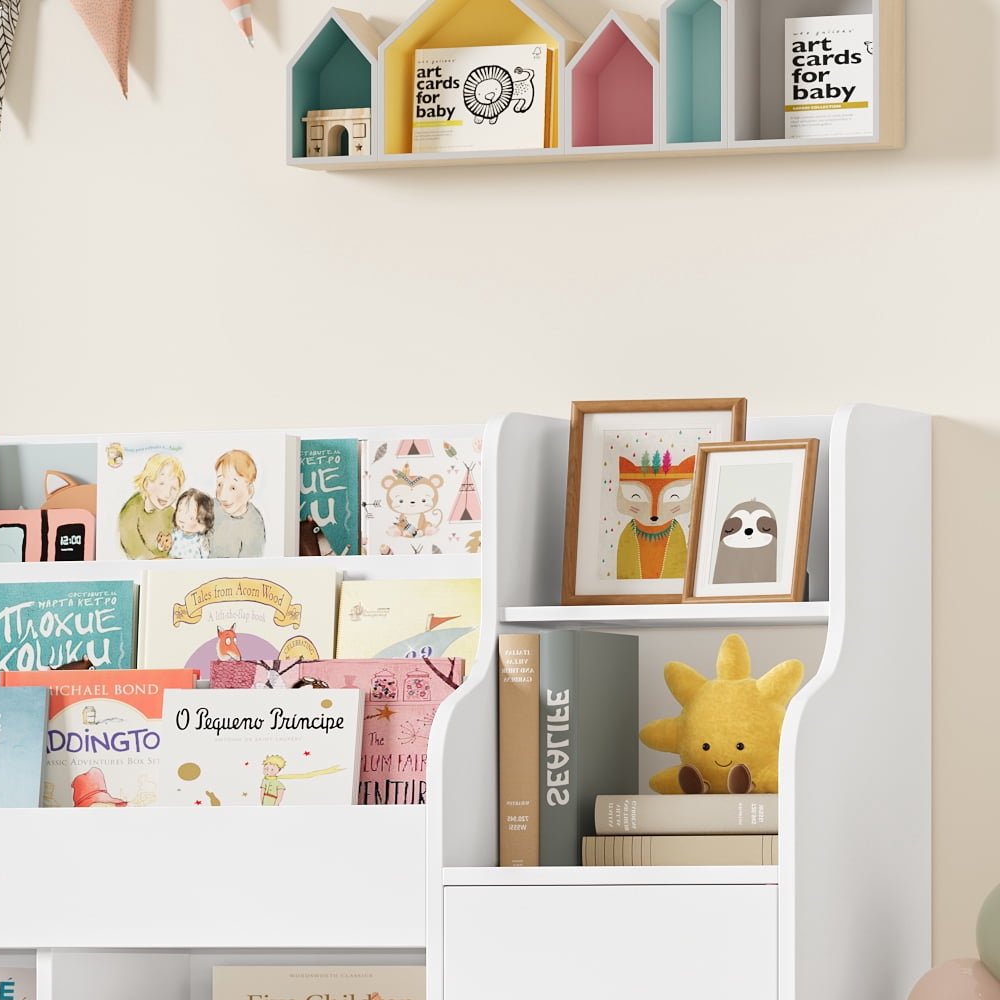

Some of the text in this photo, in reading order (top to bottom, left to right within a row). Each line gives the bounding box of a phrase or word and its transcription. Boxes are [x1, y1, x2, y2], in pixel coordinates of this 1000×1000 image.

[792, 37, 832, 52] art
[792, 49, 862, 67] cards
[416, 65, 442, 78] art
[792, 68, 830, 84] for
[416, 76, 460, 90] cards
[416, 91, 441, 104] for
[793, 83, 856, 102] baby
[416, 105, 456, 120] baby
[190, 582, 285, 606] Tales from Acorn Wood
[114, 683, 159, 696] BOND
[175, 707, 345, 737] O Pequeno Príncipe
[368, 732, 385, 746] The
